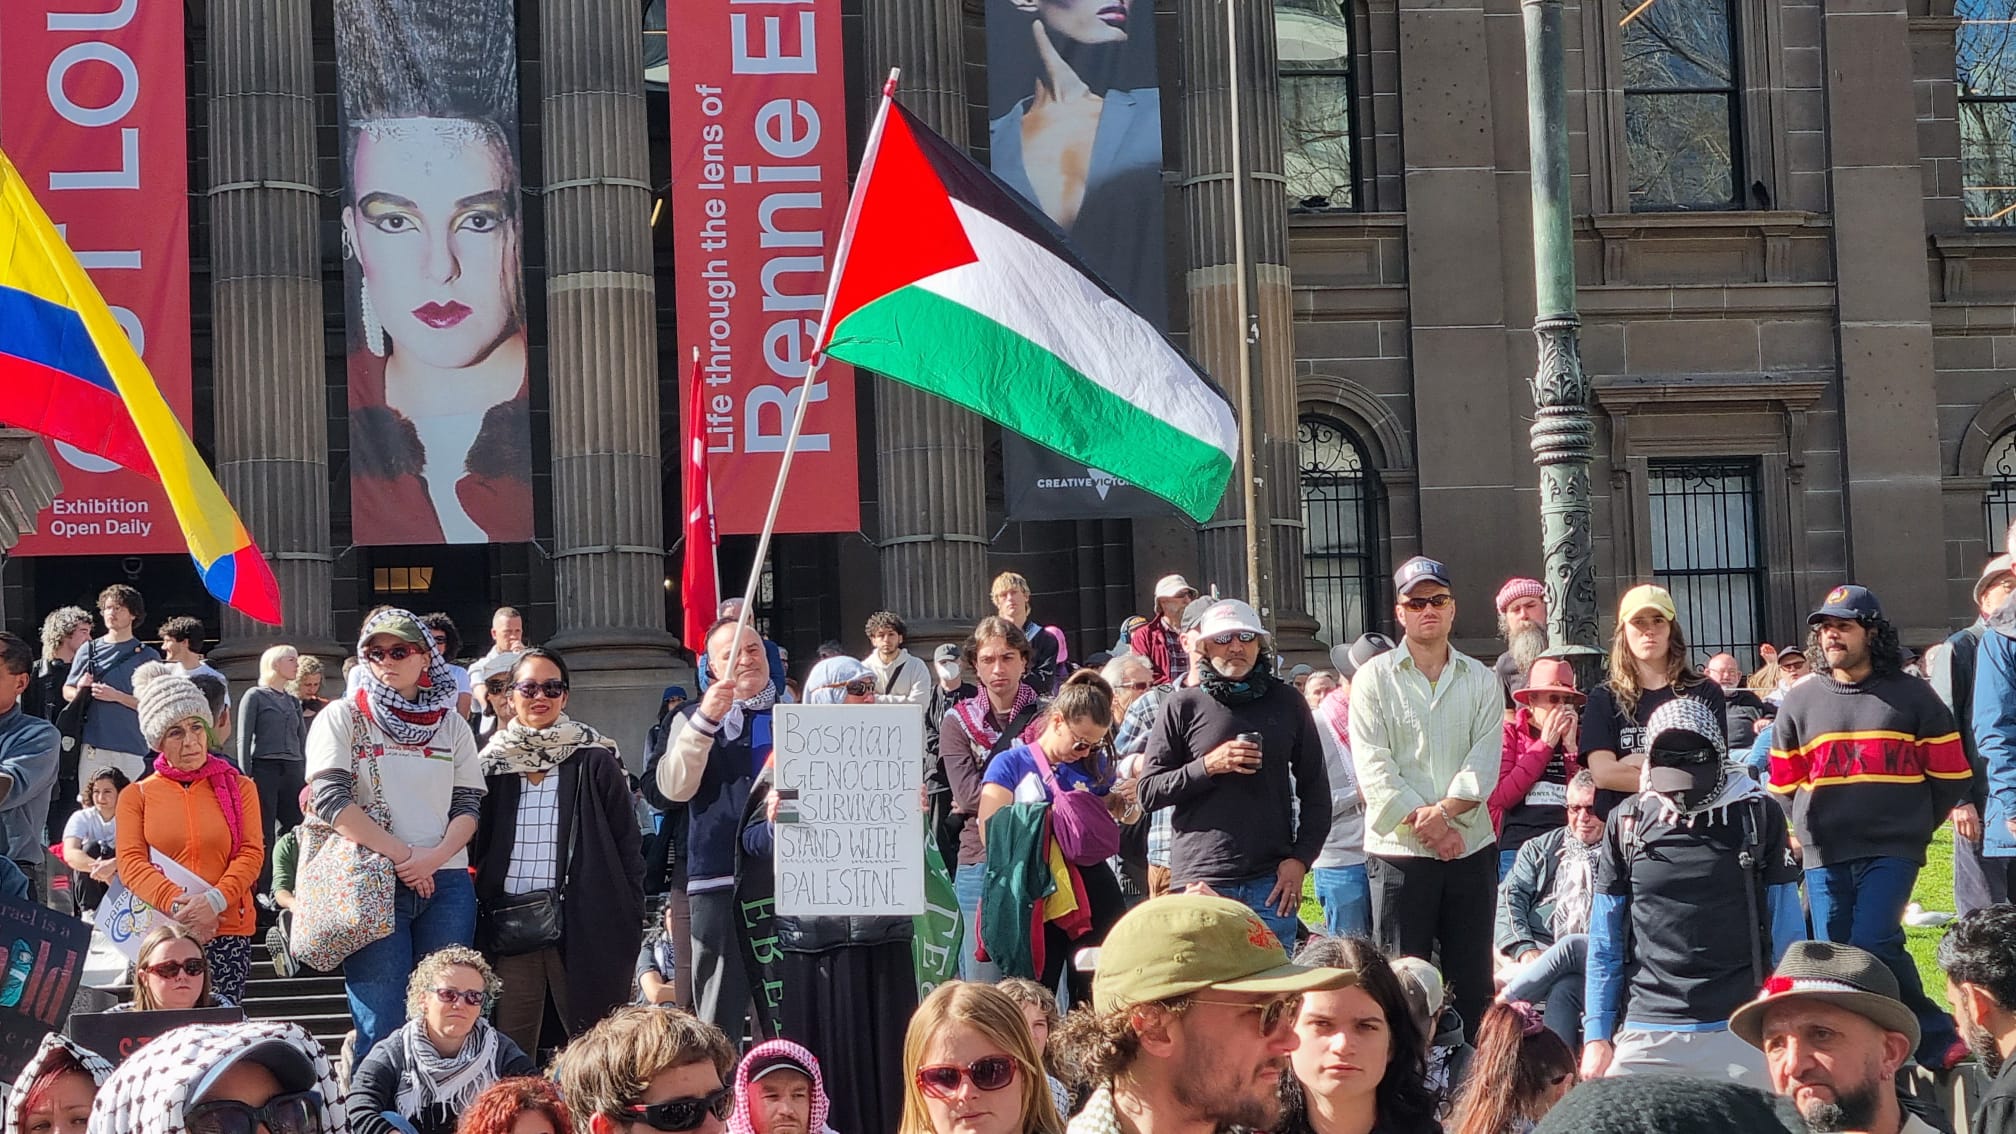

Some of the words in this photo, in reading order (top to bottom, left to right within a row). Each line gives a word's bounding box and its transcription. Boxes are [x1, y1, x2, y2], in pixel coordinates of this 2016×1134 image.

[694, 83, 723, 117] of
[698, 124, 725, 190] lens
[699, 198, 728, 252] the
[733, 98, 831, 454] Rennie
[704, 259, 737, 388] through
[707, 394, 734, 454] Life
[1036, 478, 1093, 489] CREATIVE
[53, 498, 149, 514] Exhibition
[50, 520, 101, 538] Open
[105, 518, 152, 537] Daily
[784, 712, 902, 760] Bosnian
[782, 758, 917, 791] GENOCIDE
[802, 793, 908, 822] SURVIVORS
[781, 827, 842, 859] STAND
[849, 826, 898, 859] WITH
[781, 867, 907, 908] PALESTINE
[0, 905, 37, 927] rael
[104, 890, 129, 929] PARIS
